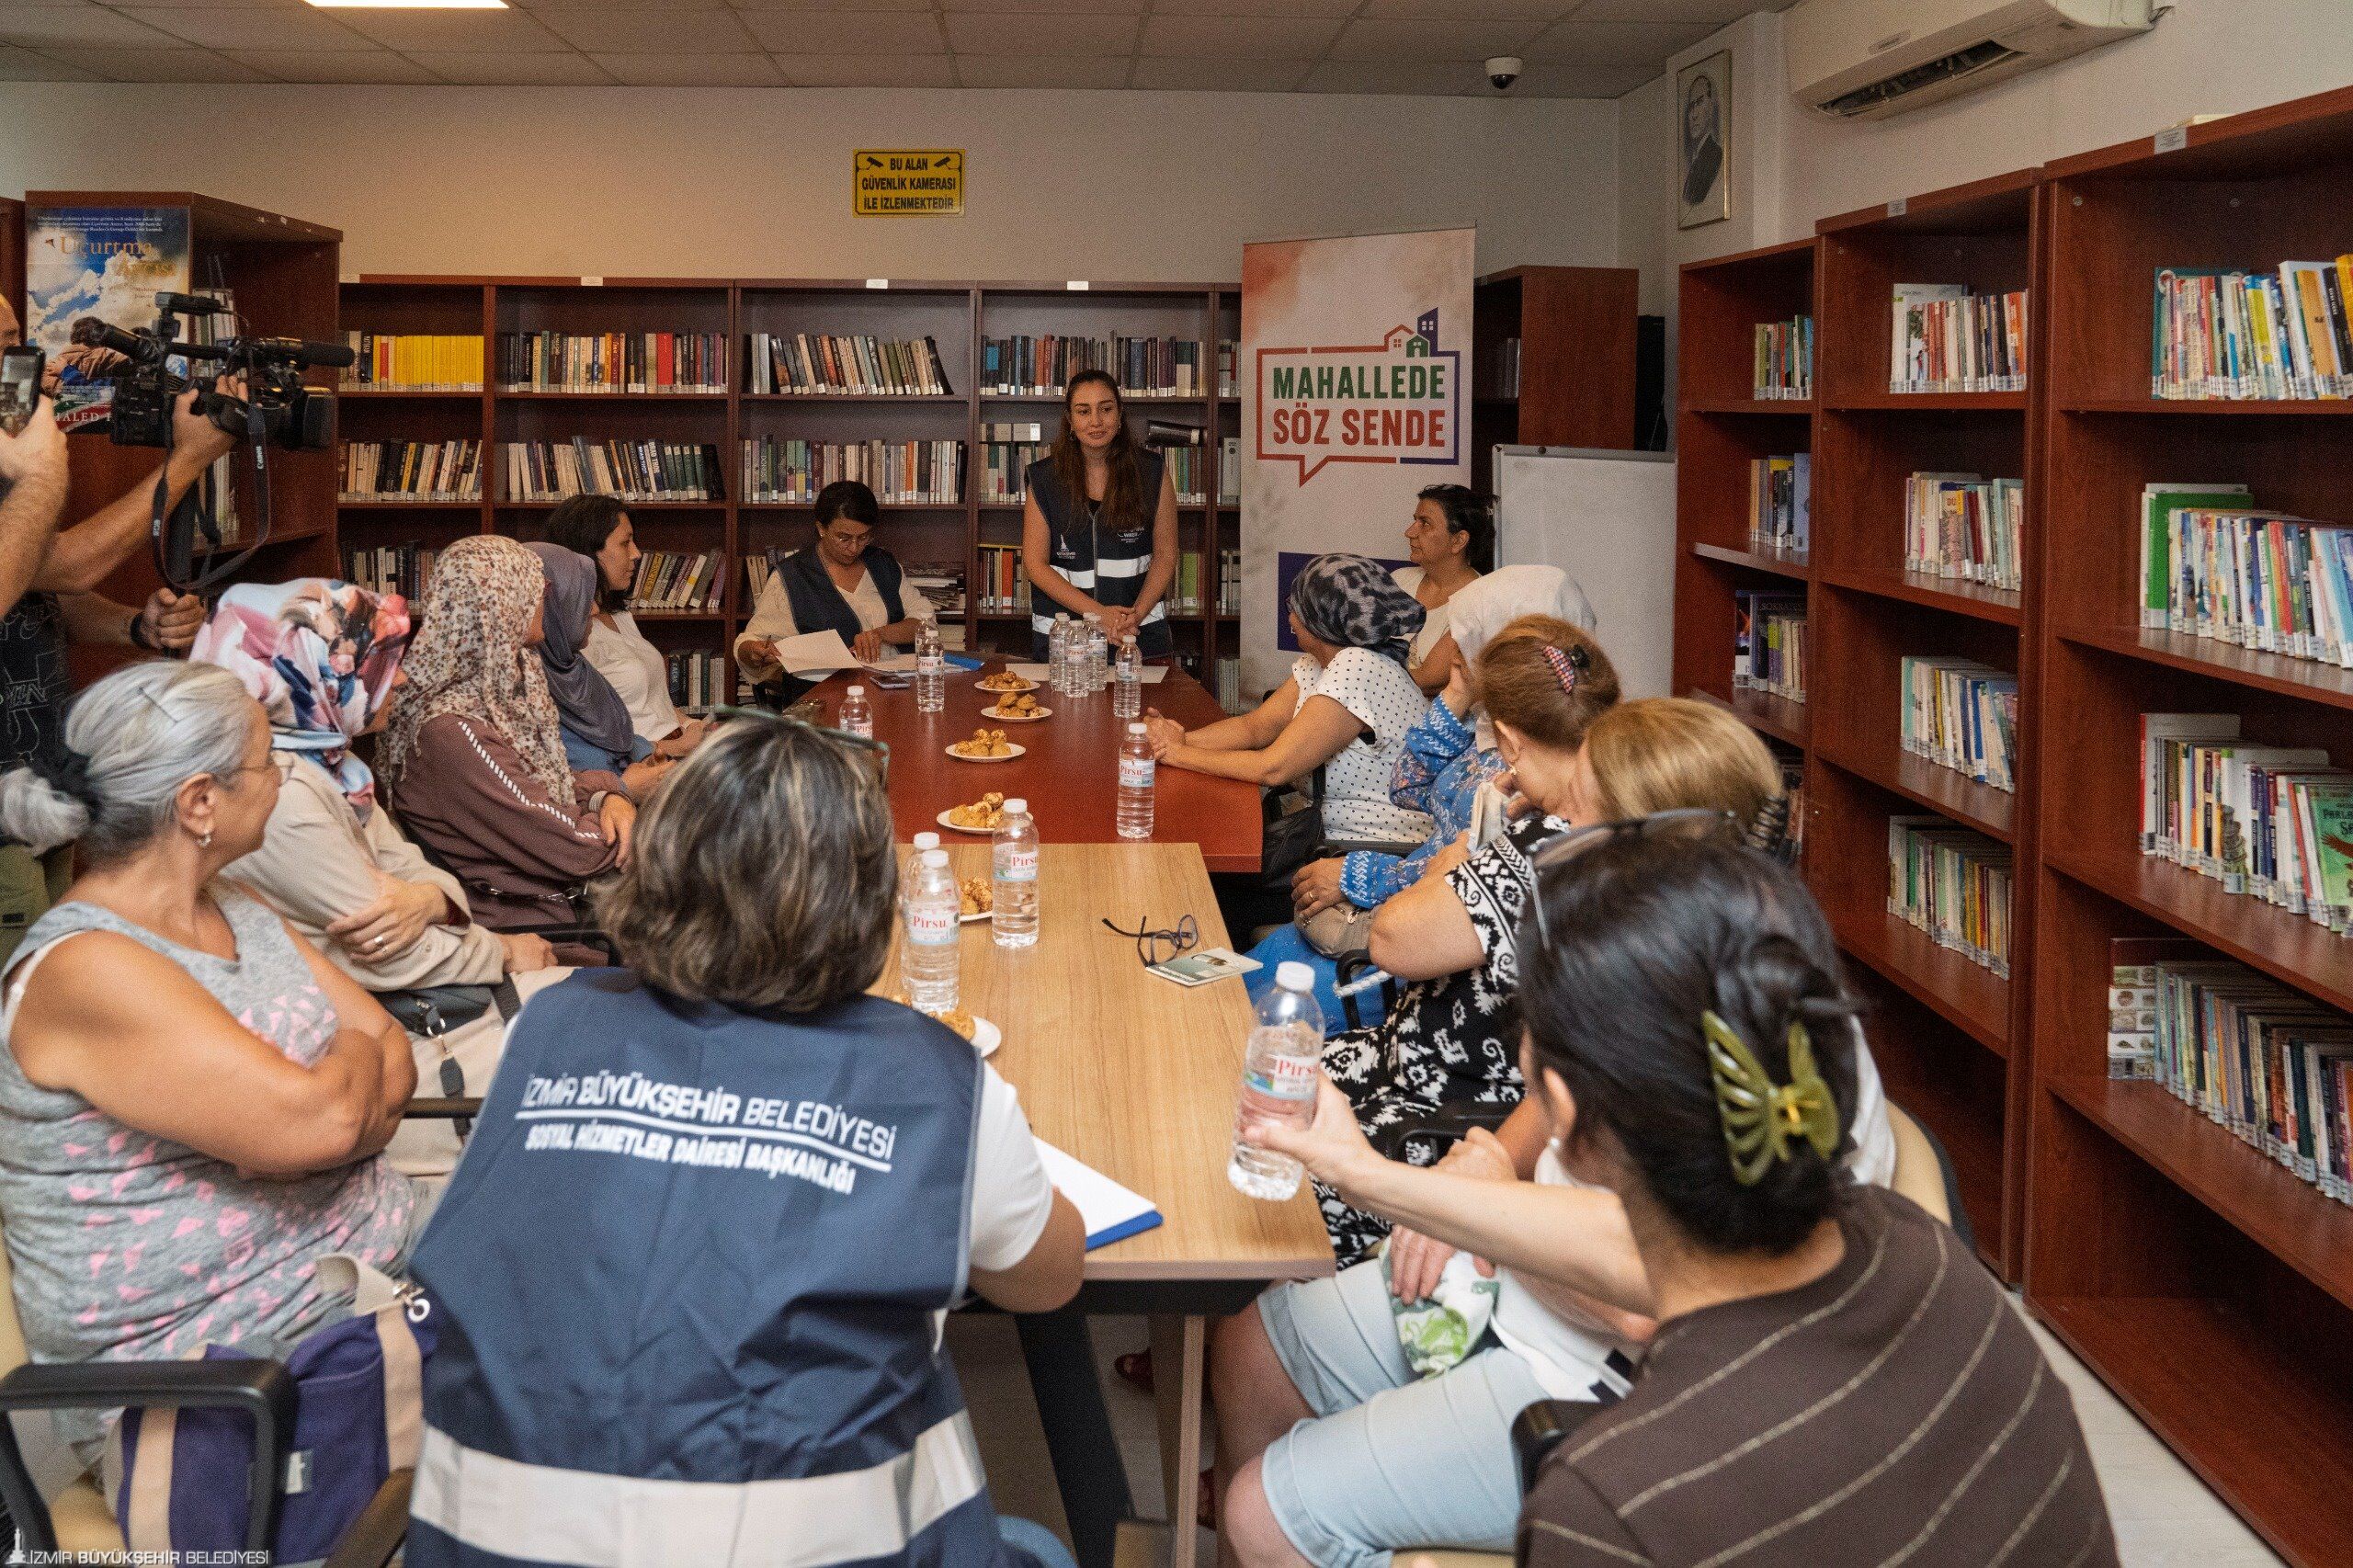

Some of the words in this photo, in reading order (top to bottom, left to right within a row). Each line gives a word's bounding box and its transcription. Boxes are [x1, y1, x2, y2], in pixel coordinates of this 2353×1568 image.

[890, 157, 903, 171] BU
[905, 157, 928, 171] ALAN
[861, 174, 907, 190] GÜVENLİK
[909, 176, 956, 190] KAMERASI
[863, 194, 878, 210] İLE
[881, 194, 954, 210] İZLENMEKTEDİR
[1273, 365, 1446, 400] MAHALLEDE
[1273, 402, 1330, 445] SÖZ
[1341, 408, 1446, 448] SENDE
[913, 915, 947, 928] Pirsu
[524, 1072, 577, 1108] İZMİR
[577, 1069, 739, 1124] BÜYÜKŞEHİR
[743, 1095, 898, 1160] BELEDİYESİ
